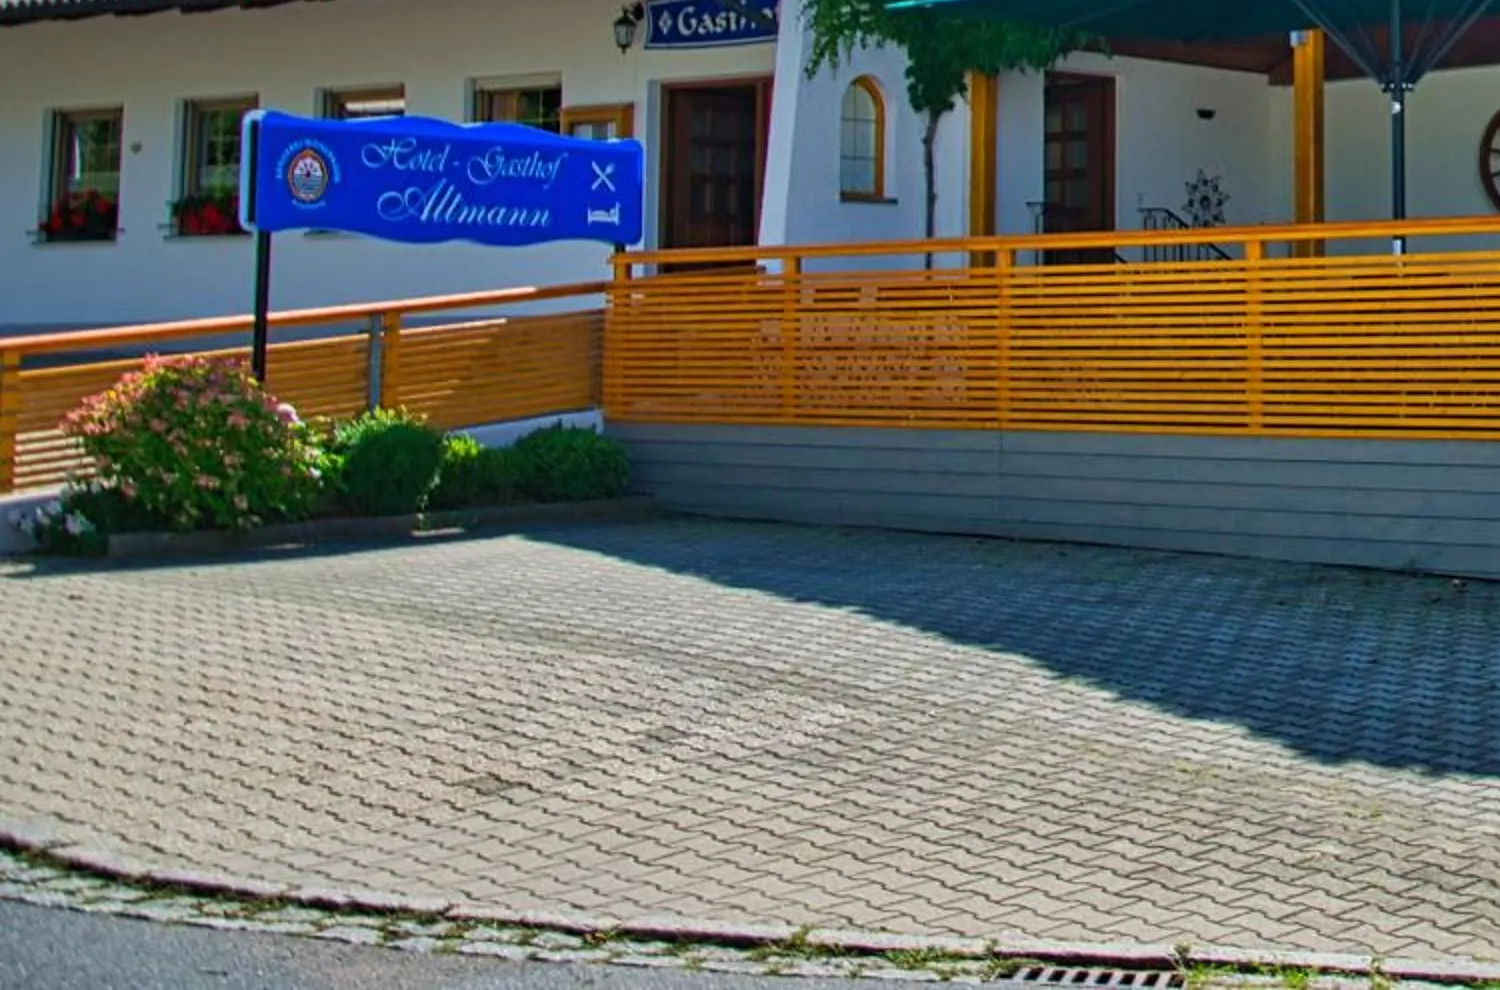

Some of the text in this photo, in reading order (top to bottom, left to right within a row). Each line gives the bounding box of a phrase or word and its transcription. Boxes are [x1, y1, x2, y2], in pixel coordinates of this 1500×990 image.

[361, 137, 450, 172] Hotel
[467, 145, 569, 191] Gasthof
[376, 177, 551, 227] Altmann
